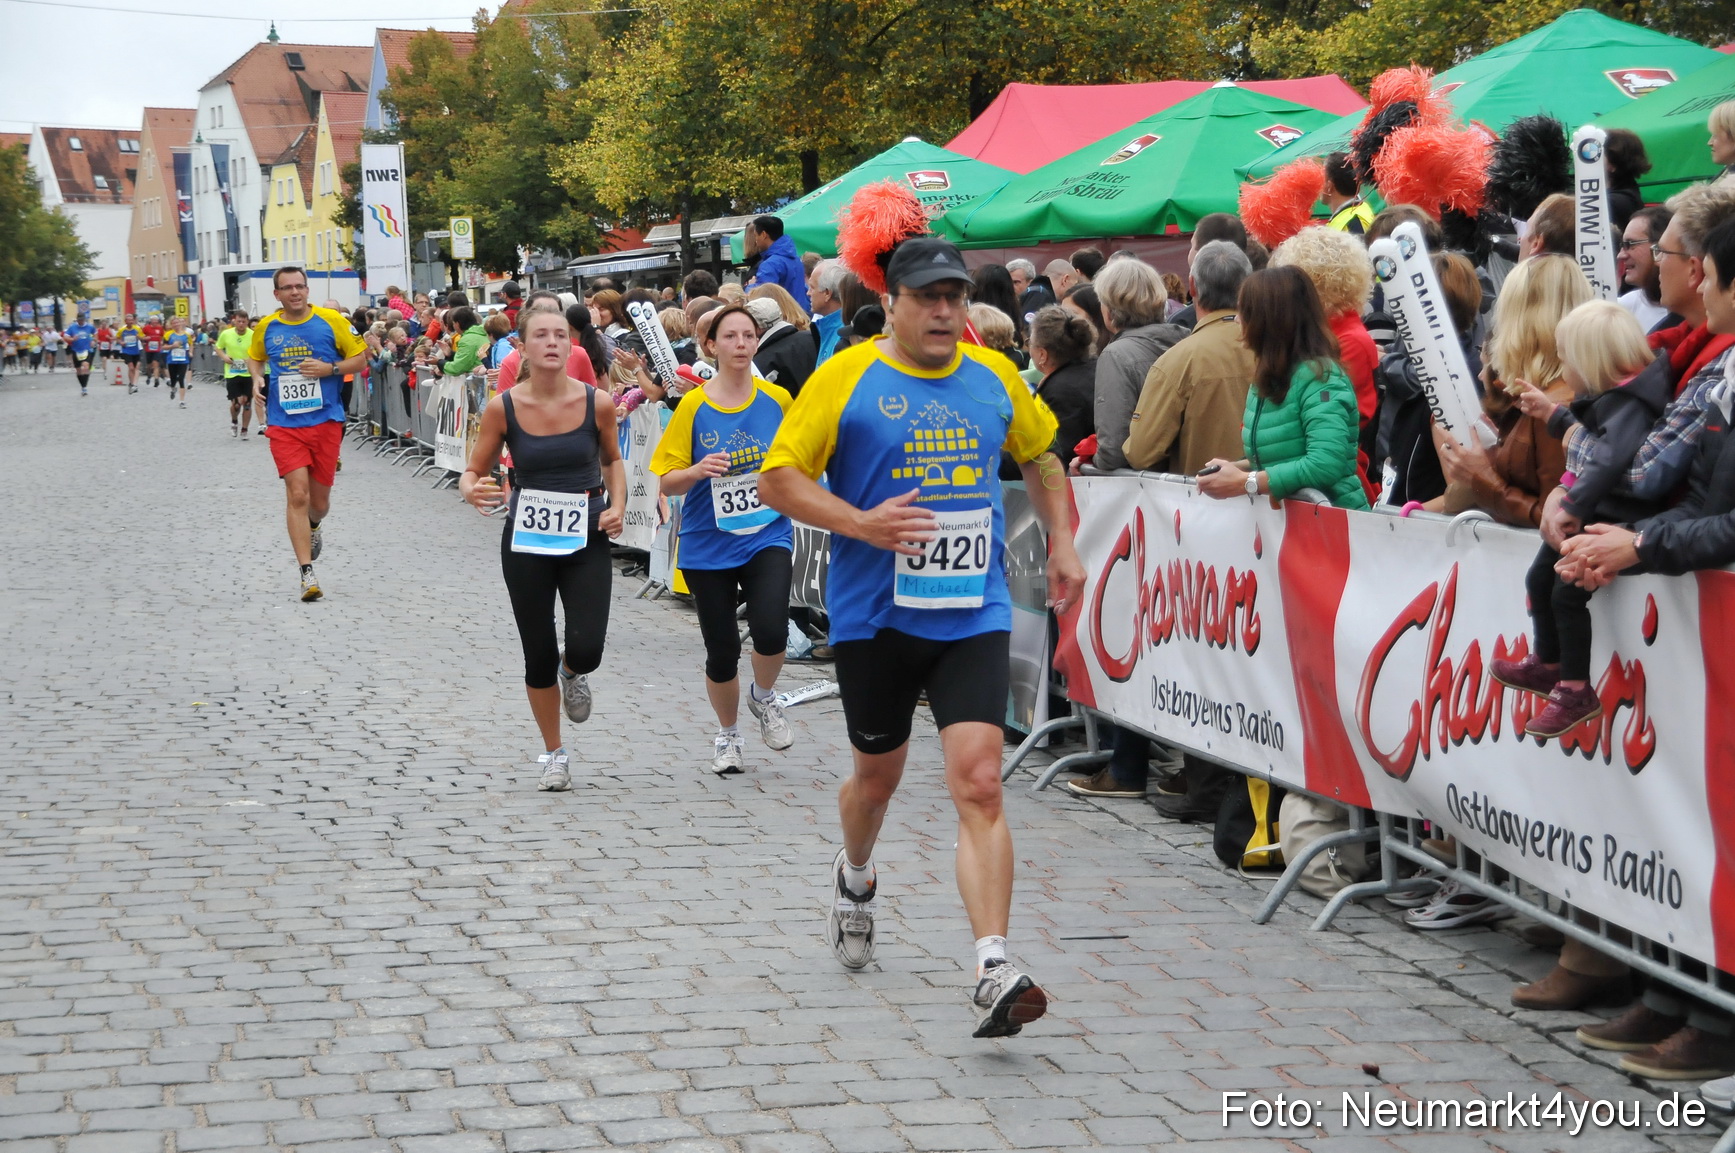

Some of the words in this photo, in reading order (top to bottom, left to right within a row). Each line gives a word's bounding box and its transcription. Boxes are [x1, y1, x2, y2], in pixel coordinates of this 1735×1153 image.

[1579, 178, 1600, 235] BMW
[637, 321, 654, 345] BMW
[649, 345, 676, 390] Laufsport
[282, 383, 316, 399] 3387
[285, 400, 315, 410] Dieter
[906, 455, 960, 465] 21.September
[960, 453, 979, 461] 2014
[713, 481, 736, 489] PARTL
[737, 479, 759, 487] Neum
[520, 494, 542, 503] PARTL
[543, 498, 577, 507] Neumarkt
[720, 486, 762, 514] 333
[522, 505, 582, 533] 3312
[938, 520, 981, 531] Neumarkt
[906, 533, 987, 571] 3420
[1089, 506, 1263, 683] Charivari
[1354, 561, 1659, 783] Charri
[1150, 674, 1232, 735] Ostbayerns
[1236, 702, 1284, 751] Radio
[1446, 782, 1594, 875] Ostbayerns
[1603, 833, 1683, 910] Radio
